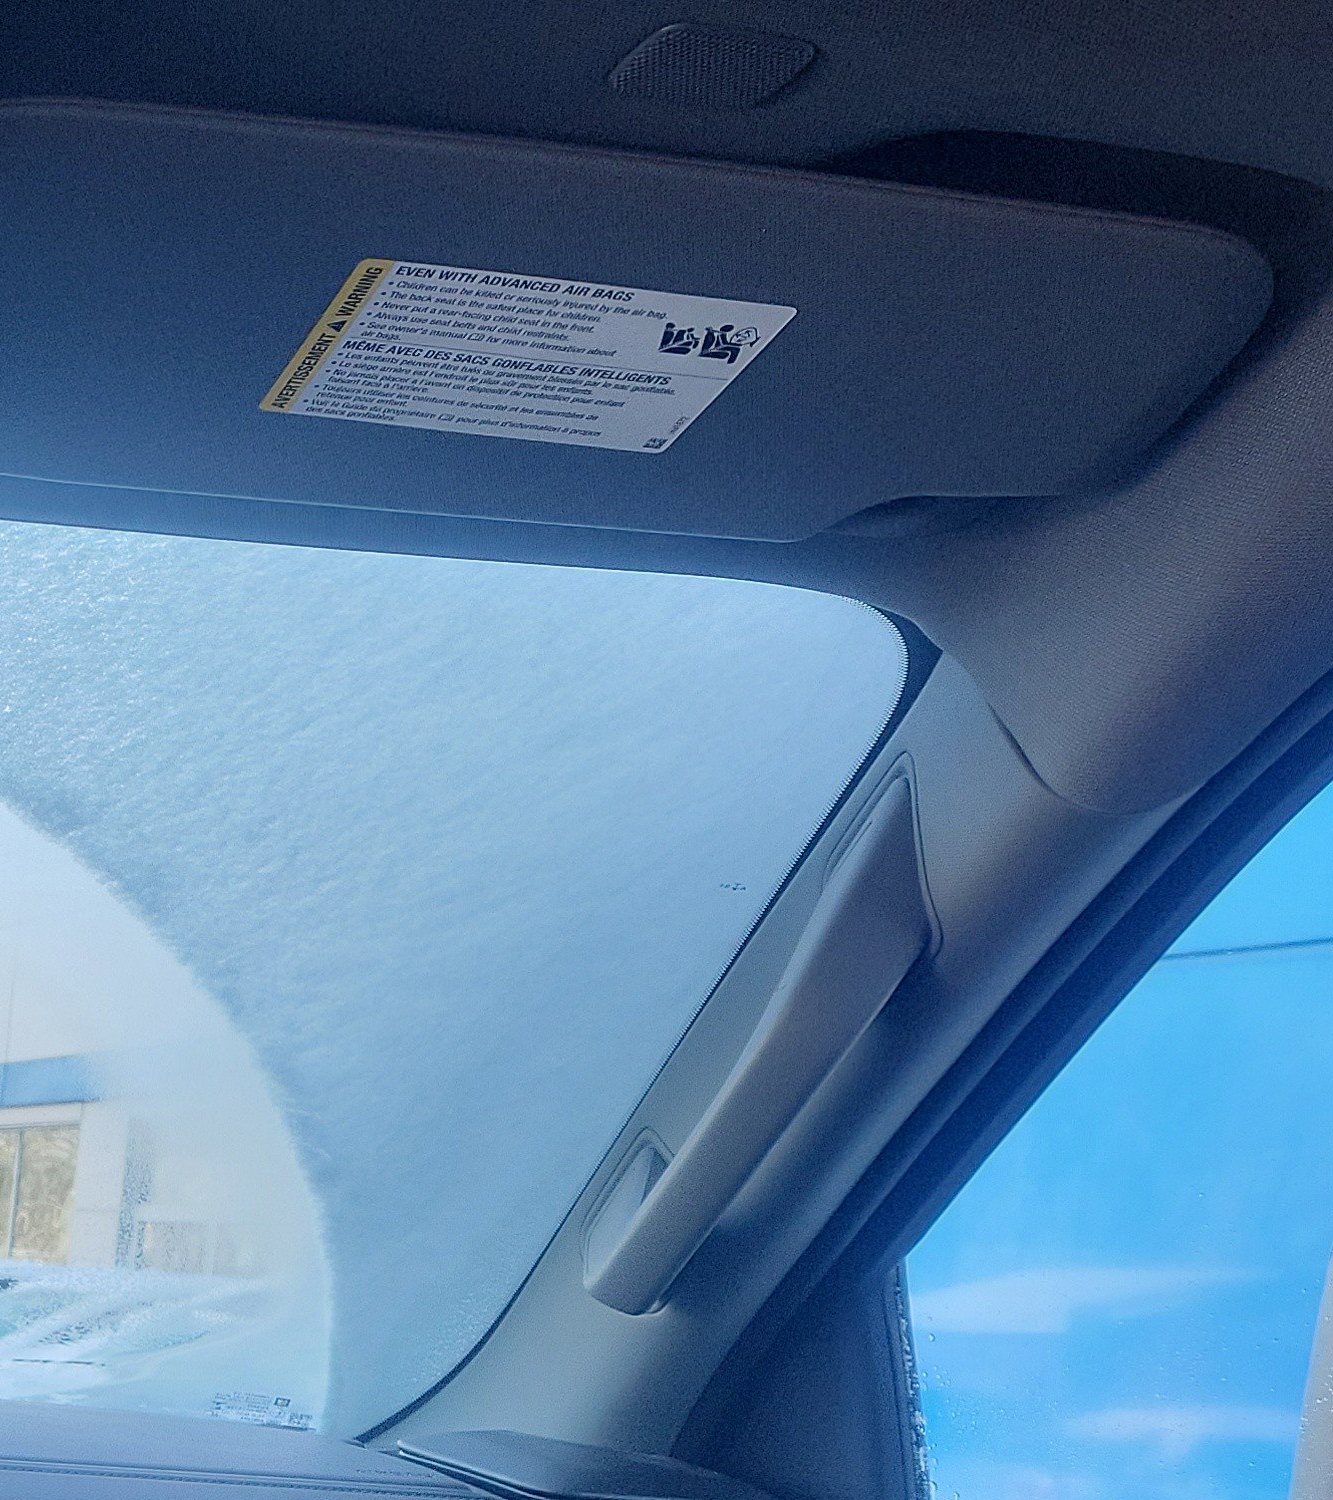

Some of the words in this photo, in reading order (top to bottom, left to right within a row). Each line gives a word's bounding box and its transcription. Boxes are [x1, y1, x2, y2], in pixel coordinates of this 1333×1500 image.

[395, 265, 435, 279] EVEN
[438, 269, 478, 283] WITH
[478, 274, 561, 293] ADVANCED
[562, 284, 591, 297] AIR
[591, 288, 636, 302] BAGS
[396, 280, 437, 292] Children
[440, 286, 459, 294] can
[460, 287, 474, 296] be
[475, 288, 503, 300] killed
[504, 293, 515, 301] or
[515, 294, 561, 308] seriously
[562, 299, 601, 311] injured
[600, 303, 613, 314] by
[613, 306, 631, 315] the
[631, 308, 645, 317] air
[646, 311, 668, 320] bag.
[374, 311, 409, 323] Always
[410, 316, 428, 324] use
[429, 317, 452, 327] seat
[477, 323, 497, 332] and
[497, 325, 522, 336] child
[381, 301, 411, 311] Never
[411, 304, 428, 314] put
[437, 308, 492, 322] rear-facing
[492, 313, 517, 324] child
[518, 316, 540, 327] seat
[541, 319, 551, 328] in
[552, 320, 569, 330] the
[390, 290, 408, 300] The
[410, 293, 432, 303] back
[434, 296, 458, 305] seat
[458, 298, 467, 307] is
[468, 299, 484, 309] the
[485, 302, 517, 313] safest
[517, 306, 544, 318] place
[545, 308, 560, 317] for
[561, 311, 601, 323] children.
[271, 332, 337, 409] AVERTISSEMENT
[335, 266, 384, 317] WARNING
[366, 321, 386, 330] See
[388, 323, 429, 334] owner's
[429, 329, 467, 340] manual
[486, 334, 503, 344] for
[502, 338, 529, 347] more
[587, 347, 618, 357] about
[338, 360, 350, 368] Le
[341, 339, 389, 353] MÊME
[386, 345, 424, 357] AVEC
[423, 350, 454, 361] DES
[453, 353, 491, 365] SACS
[492, 358, 579, 376] GONFLABLES
[578, 367, 672, 386] INTELLIGENTS
[345, 352, 362, 360] Les
[400, 359, 440, 370] peuvent
